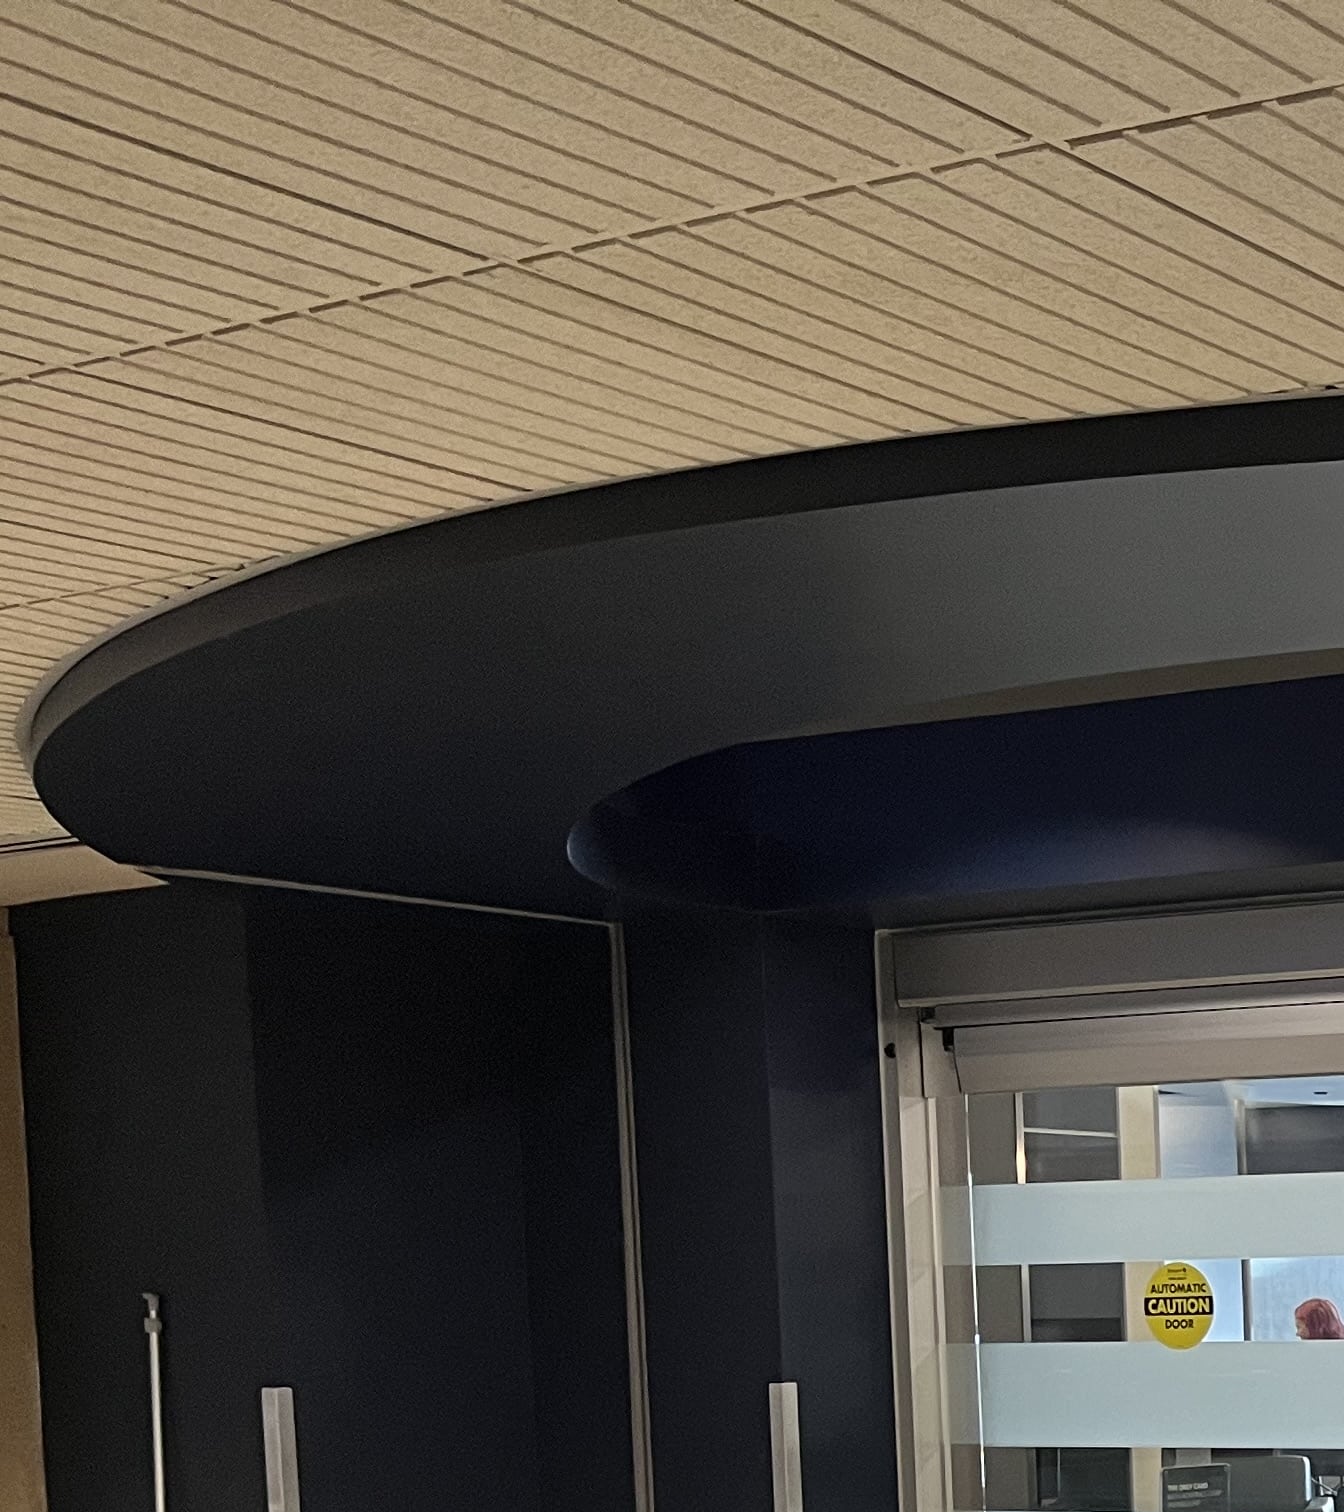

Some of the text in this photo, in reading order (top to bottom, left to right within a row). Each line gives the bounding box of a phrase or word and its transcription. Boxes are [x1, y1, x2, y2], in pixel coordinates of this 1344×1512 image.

[1150, 1283, 1207, 1294] AUTOMATIC
[1148, 1297, 1210, 1314] CAUTION
[1165, 1319, 1194, 1329] DOOR
